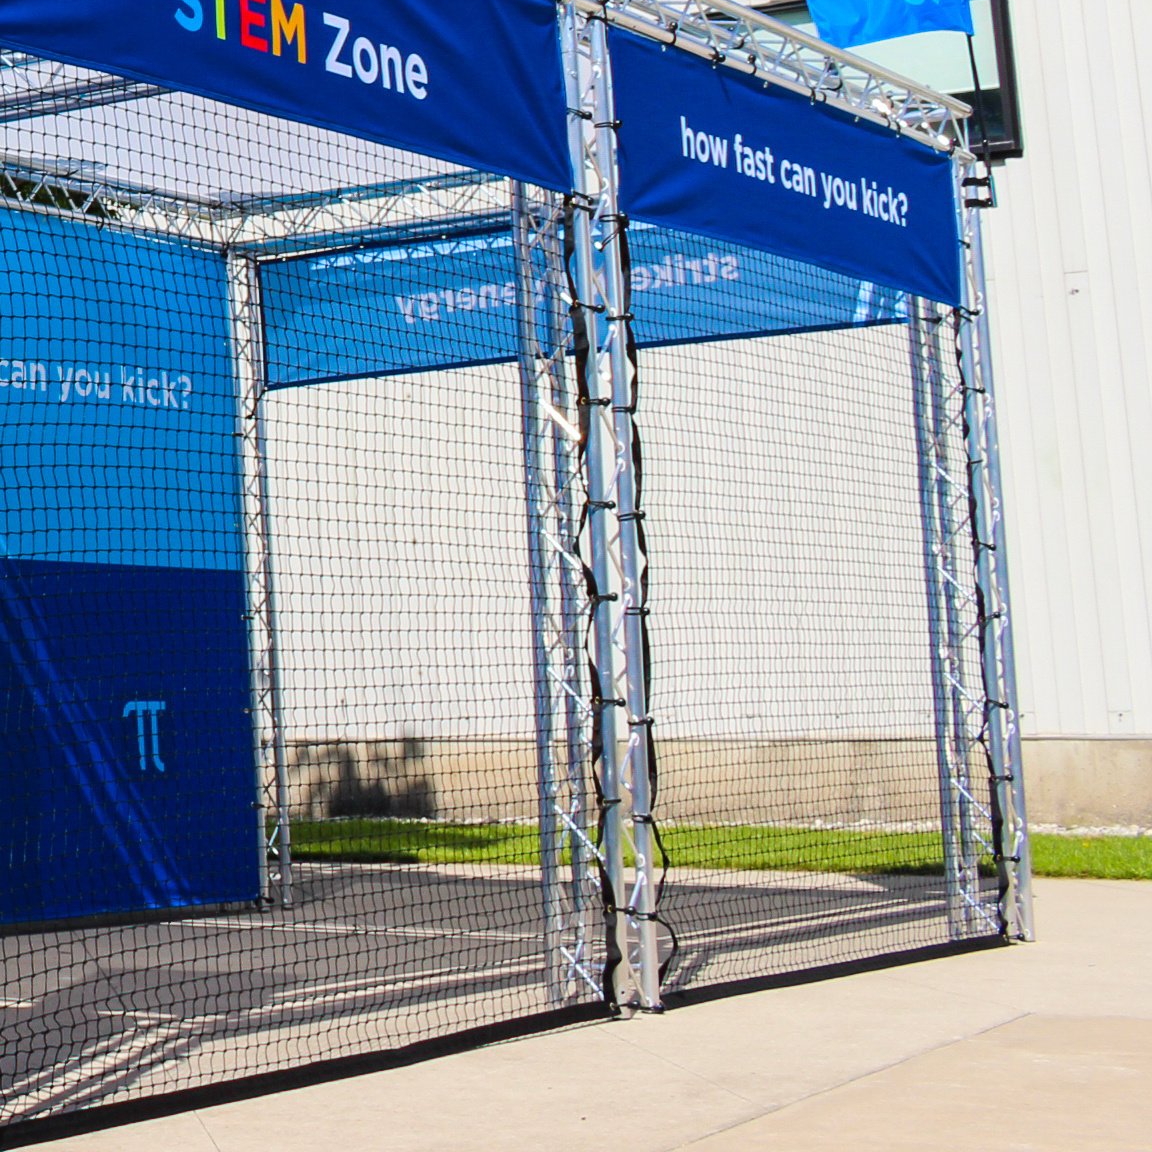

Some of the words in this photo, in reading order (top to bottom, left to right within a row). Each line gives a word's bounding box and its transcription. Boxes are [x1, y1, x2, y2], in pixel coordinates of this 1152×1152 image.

[323, 11, 429, 100] Zone
[680, 116, 728, 168] how
[734, 134, 775, 184] fast
[780, 159, 817, 197] can
[821, 172, 857, 209] you
[861, 178, 908, 227] kick?
[56, 362, 111, 403] you
[120, 366, 193, 409] kick?
